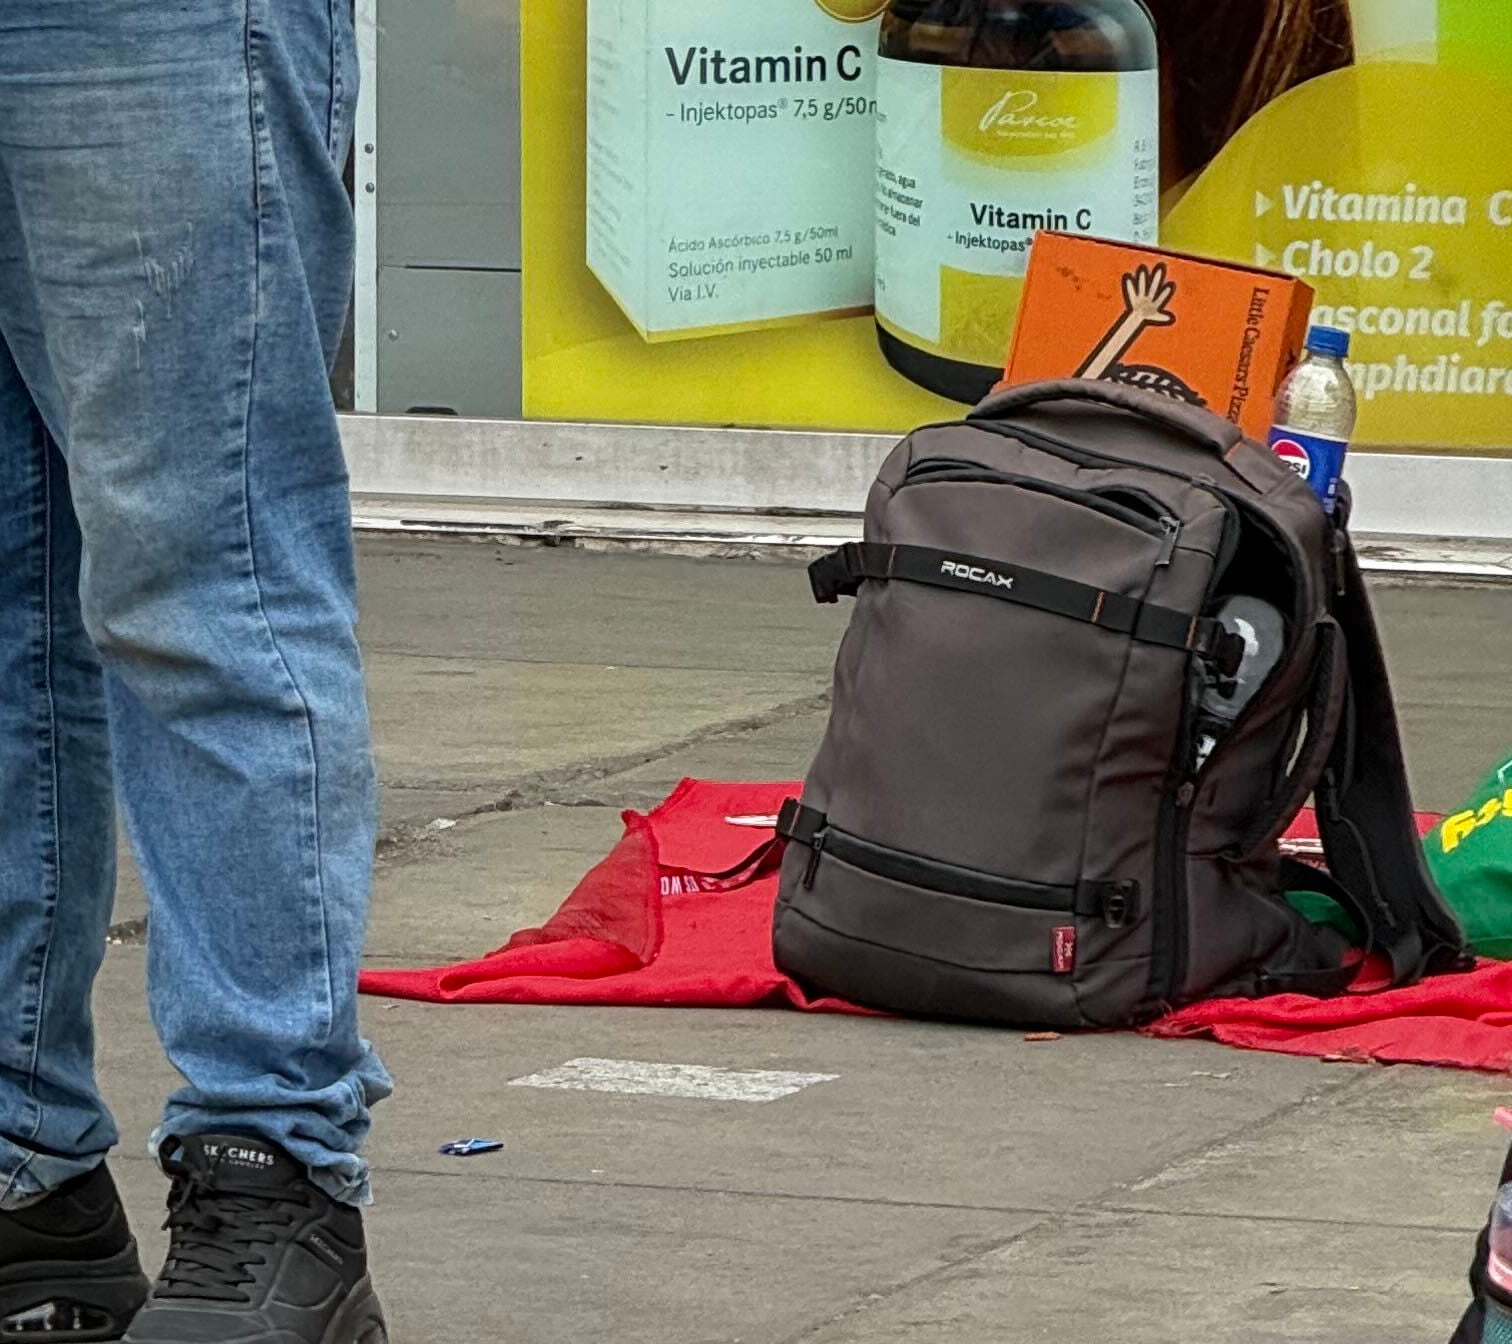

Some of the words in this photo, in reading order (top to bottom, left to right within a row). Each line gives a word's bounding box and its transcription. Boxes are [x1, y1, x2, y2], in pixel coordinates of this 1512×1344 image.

[664, 45, 827, 86] Vitamin
[837, 44, 862, 82] C
[978, 90, 1080, 132] Pascoe
[970, 203, 1068, 231] Vitamin
[1076, 208, 1092, 230] C
[1282, 180, 1468, 225] Vitamina
[668, 259, 734, 278] Solución
[738, 250, 810, 274] inyectable
[814, 247, 832, 263] 50
[836, 245, 853, 261] ml
[1282, 239, 1400, 279] Cholo
[1407, 244, 1434, 280] 2
[1246, 287, 1270, 325] Little
[1309, 299, 1471, 338] asconal
[1236, 327, 1260, 382] Caesars
[1226, 384, 1249, 425] Pizz
[940, 560, 1014, 590] ROCAX
[203, 1144, 274, 1165] SKCHERS
